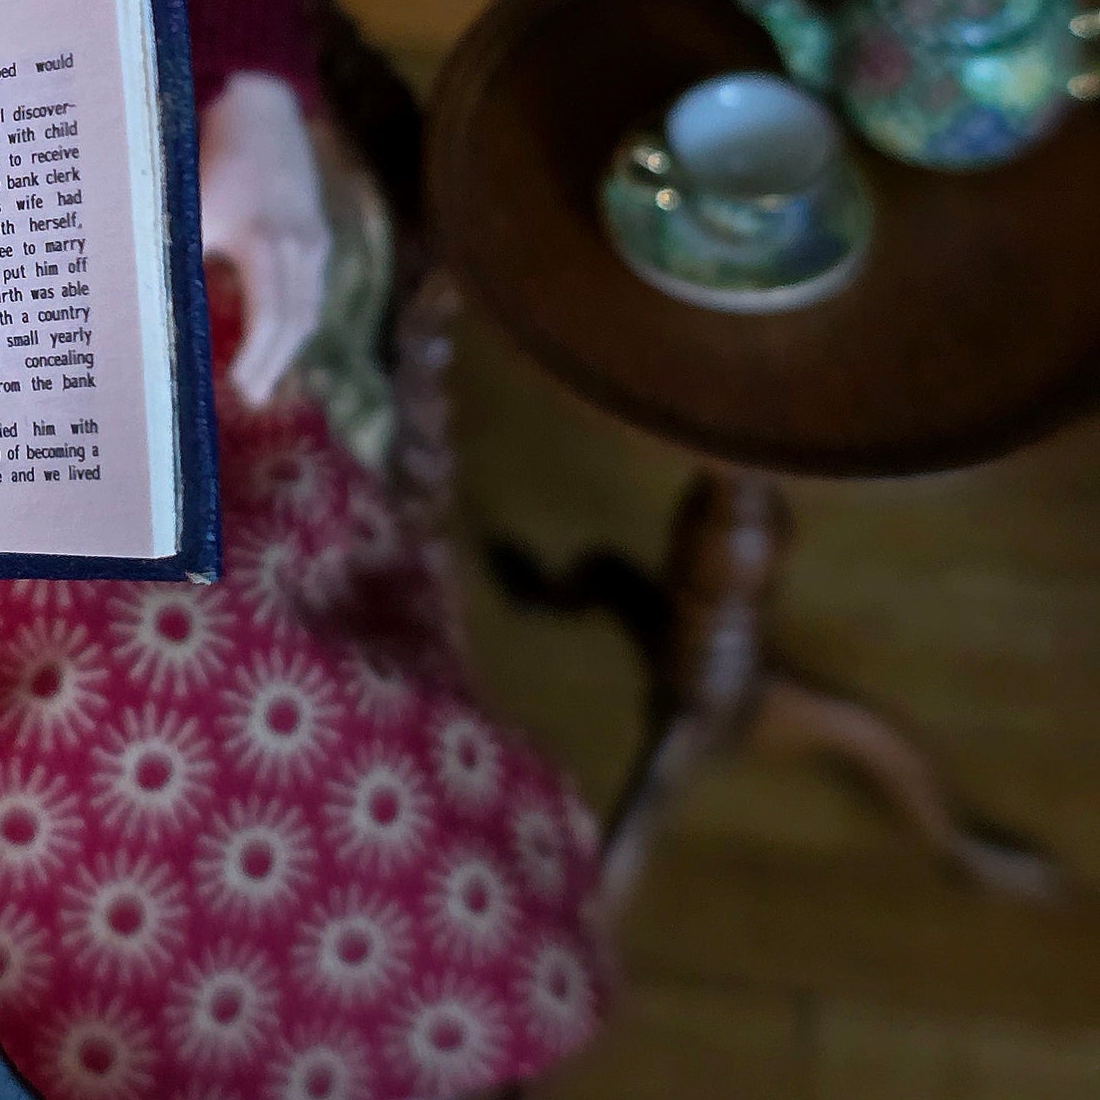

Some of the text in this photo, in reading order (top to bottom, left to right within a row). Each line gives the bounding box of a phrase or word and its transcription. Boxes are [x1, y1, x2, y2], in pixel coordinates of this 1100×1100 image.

[35, 53, 74, 73] would
[0, 108, 5, 123] I
[7, 127, 36, 145] with
[44, 120, 78, 139] child
[9, 153, 22, 167] to
[31, 145, 80, 164] receive
[7, 172, 40, 190] bank
[46, 167, 81, 185] clerk
[16, 194, 44, 211] wife
[57, 189, 83, 206] had
[23, 241, 36, 256] to
[45, 238, 86, 255] marry
[3, 264, 26, 285] put
[35, 261, 59, 277] him
[68, 257, 88, 274] off
[30, 287, 55, 300] was
[61, 282, 90, 298] able
[21, 312, 29, 324] a
[37, 305, 90, 323] country
[7, 331, 39, 348] small
[49, 328, 93, 349] yearly
[24, 350, 94, 369] concealing
[31, 376, 53, 391] the
[62, 373, 97, 391] bank
[32, 420, 56, 437] him
[70, 419, 99, 435] with
[7, 445, 20, 461] of
[26, 443, 86, 463] becoming
[91, 445, 99, 457] a
[11, 466, 35, 483] and
[43, 470, 61, 481] we
[68, 465, 101, 480] lived
